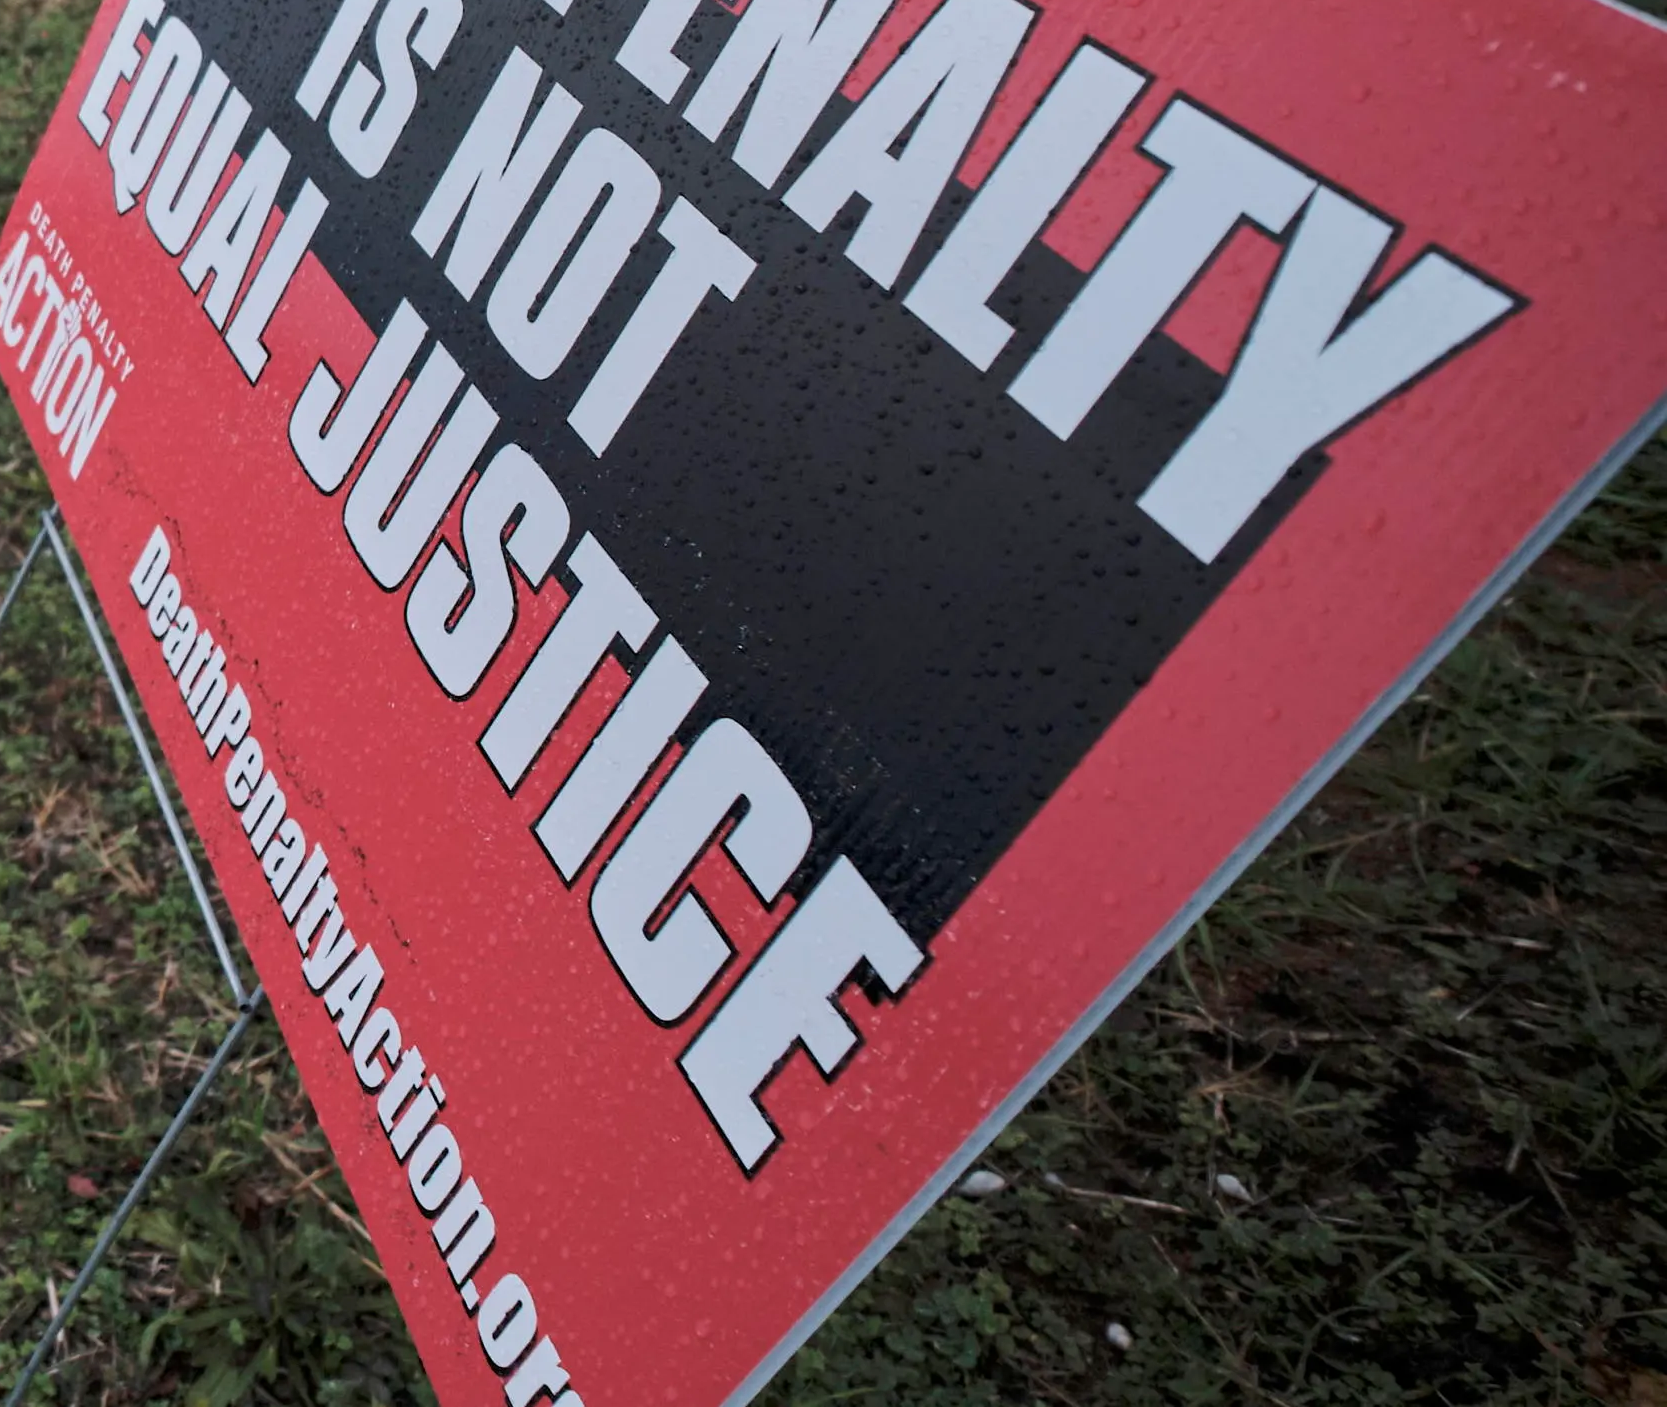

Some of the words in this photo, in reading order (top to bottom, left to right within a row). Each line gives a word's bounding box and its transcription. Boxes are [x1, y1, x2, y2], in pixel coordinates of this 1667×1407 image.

[28, 200, 75, 279] DEATH
[70, 270, 135, 383] PENALTY
[410, 45, 758, 459] NOT
[128, 524, 587, 1407] DeathPenaltyAction.or
[287, 297, 932, 1181] JUSTICE
